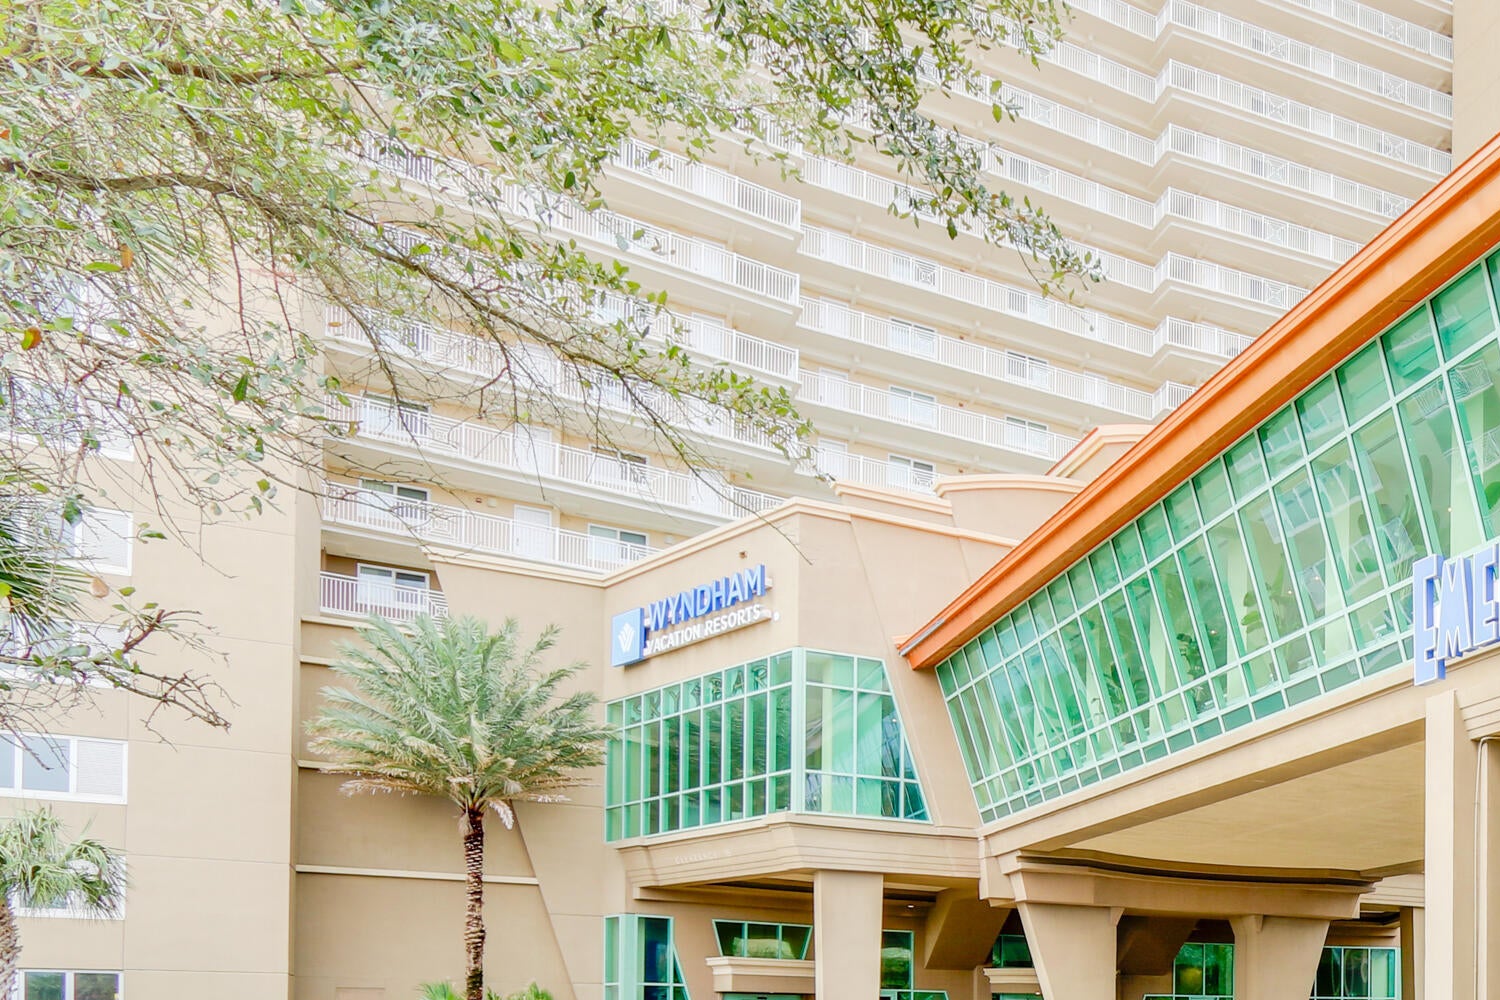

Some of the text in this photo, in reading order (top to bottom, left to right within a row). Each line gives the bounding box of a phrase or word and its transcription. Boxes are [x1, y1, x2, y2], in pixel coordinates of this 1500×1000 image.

[647, 564, 766, 632] WYNDHAM
[645, 603, 763, 653] VACATION RESORTS
